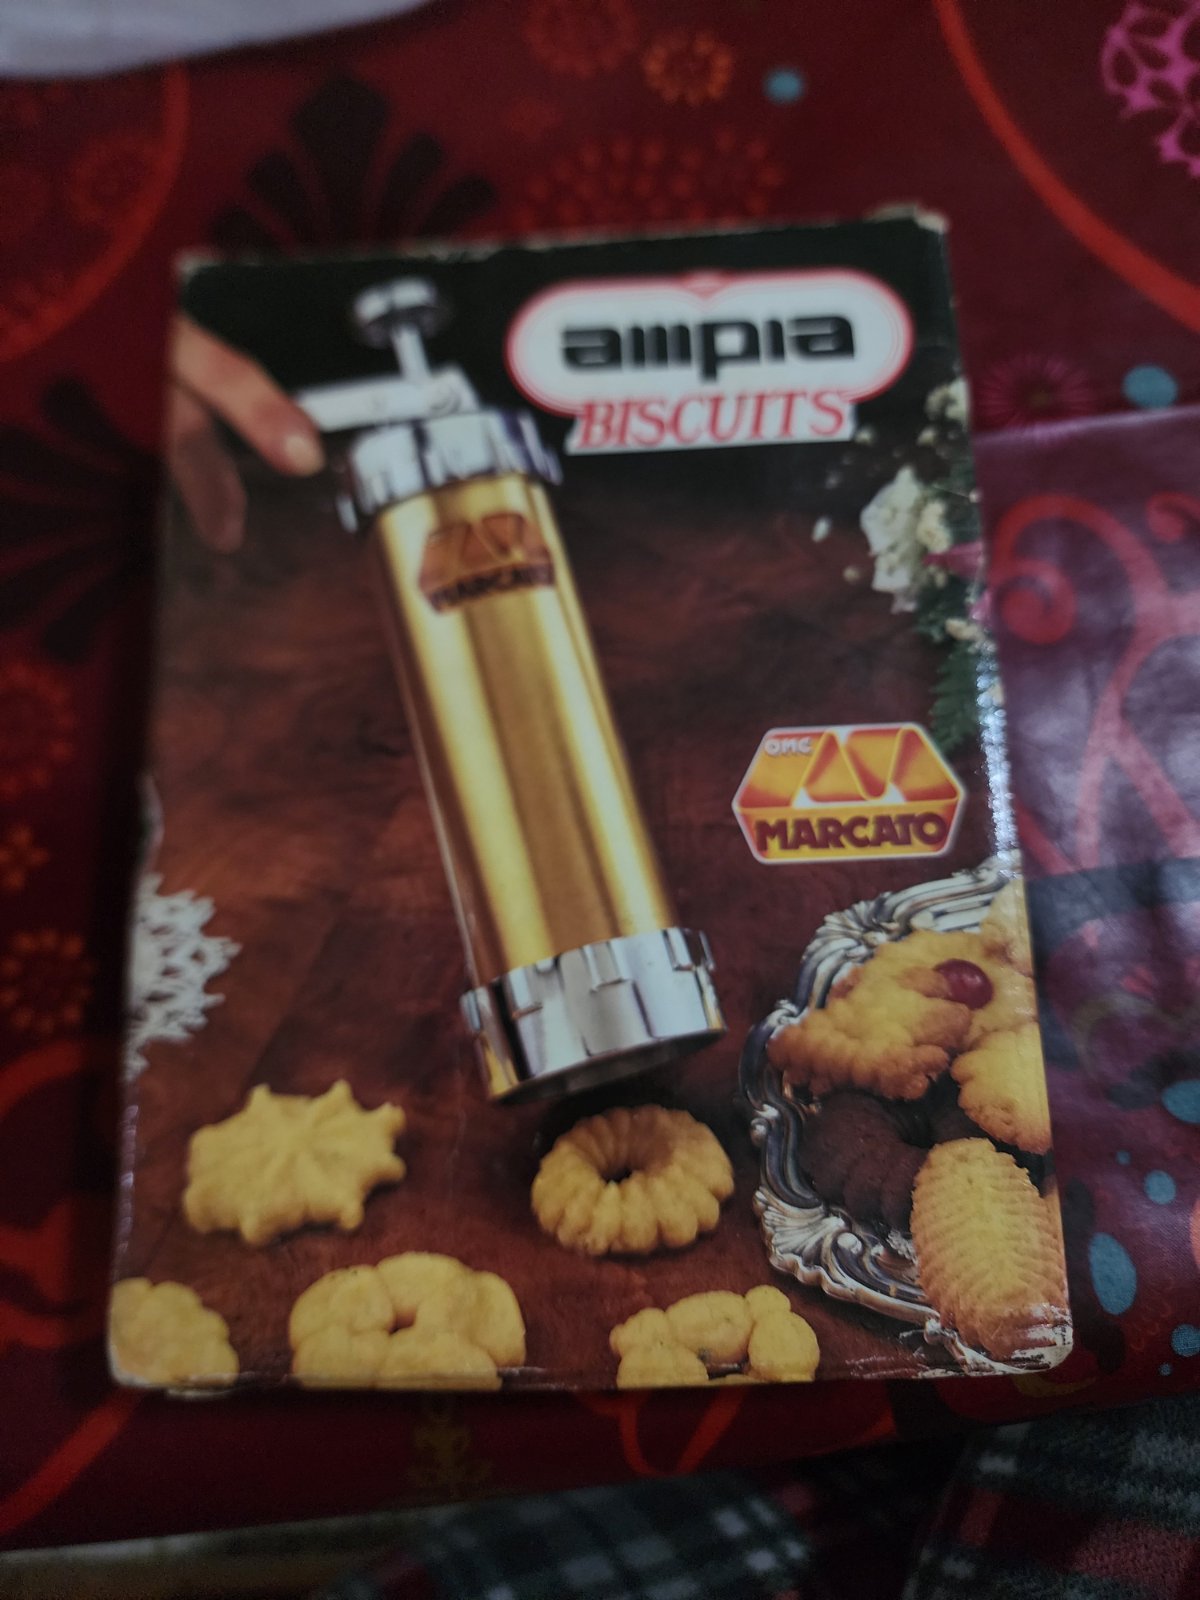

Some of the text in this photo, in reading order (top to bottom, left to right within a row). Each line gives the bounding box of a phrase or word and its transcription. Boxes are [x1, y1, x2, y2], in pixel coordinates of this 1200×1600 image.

[562, 316, 854, 384] ampia
[576, 390, 848, 449] BISCUITS
[756, 811, 947, 850] MARCATO
